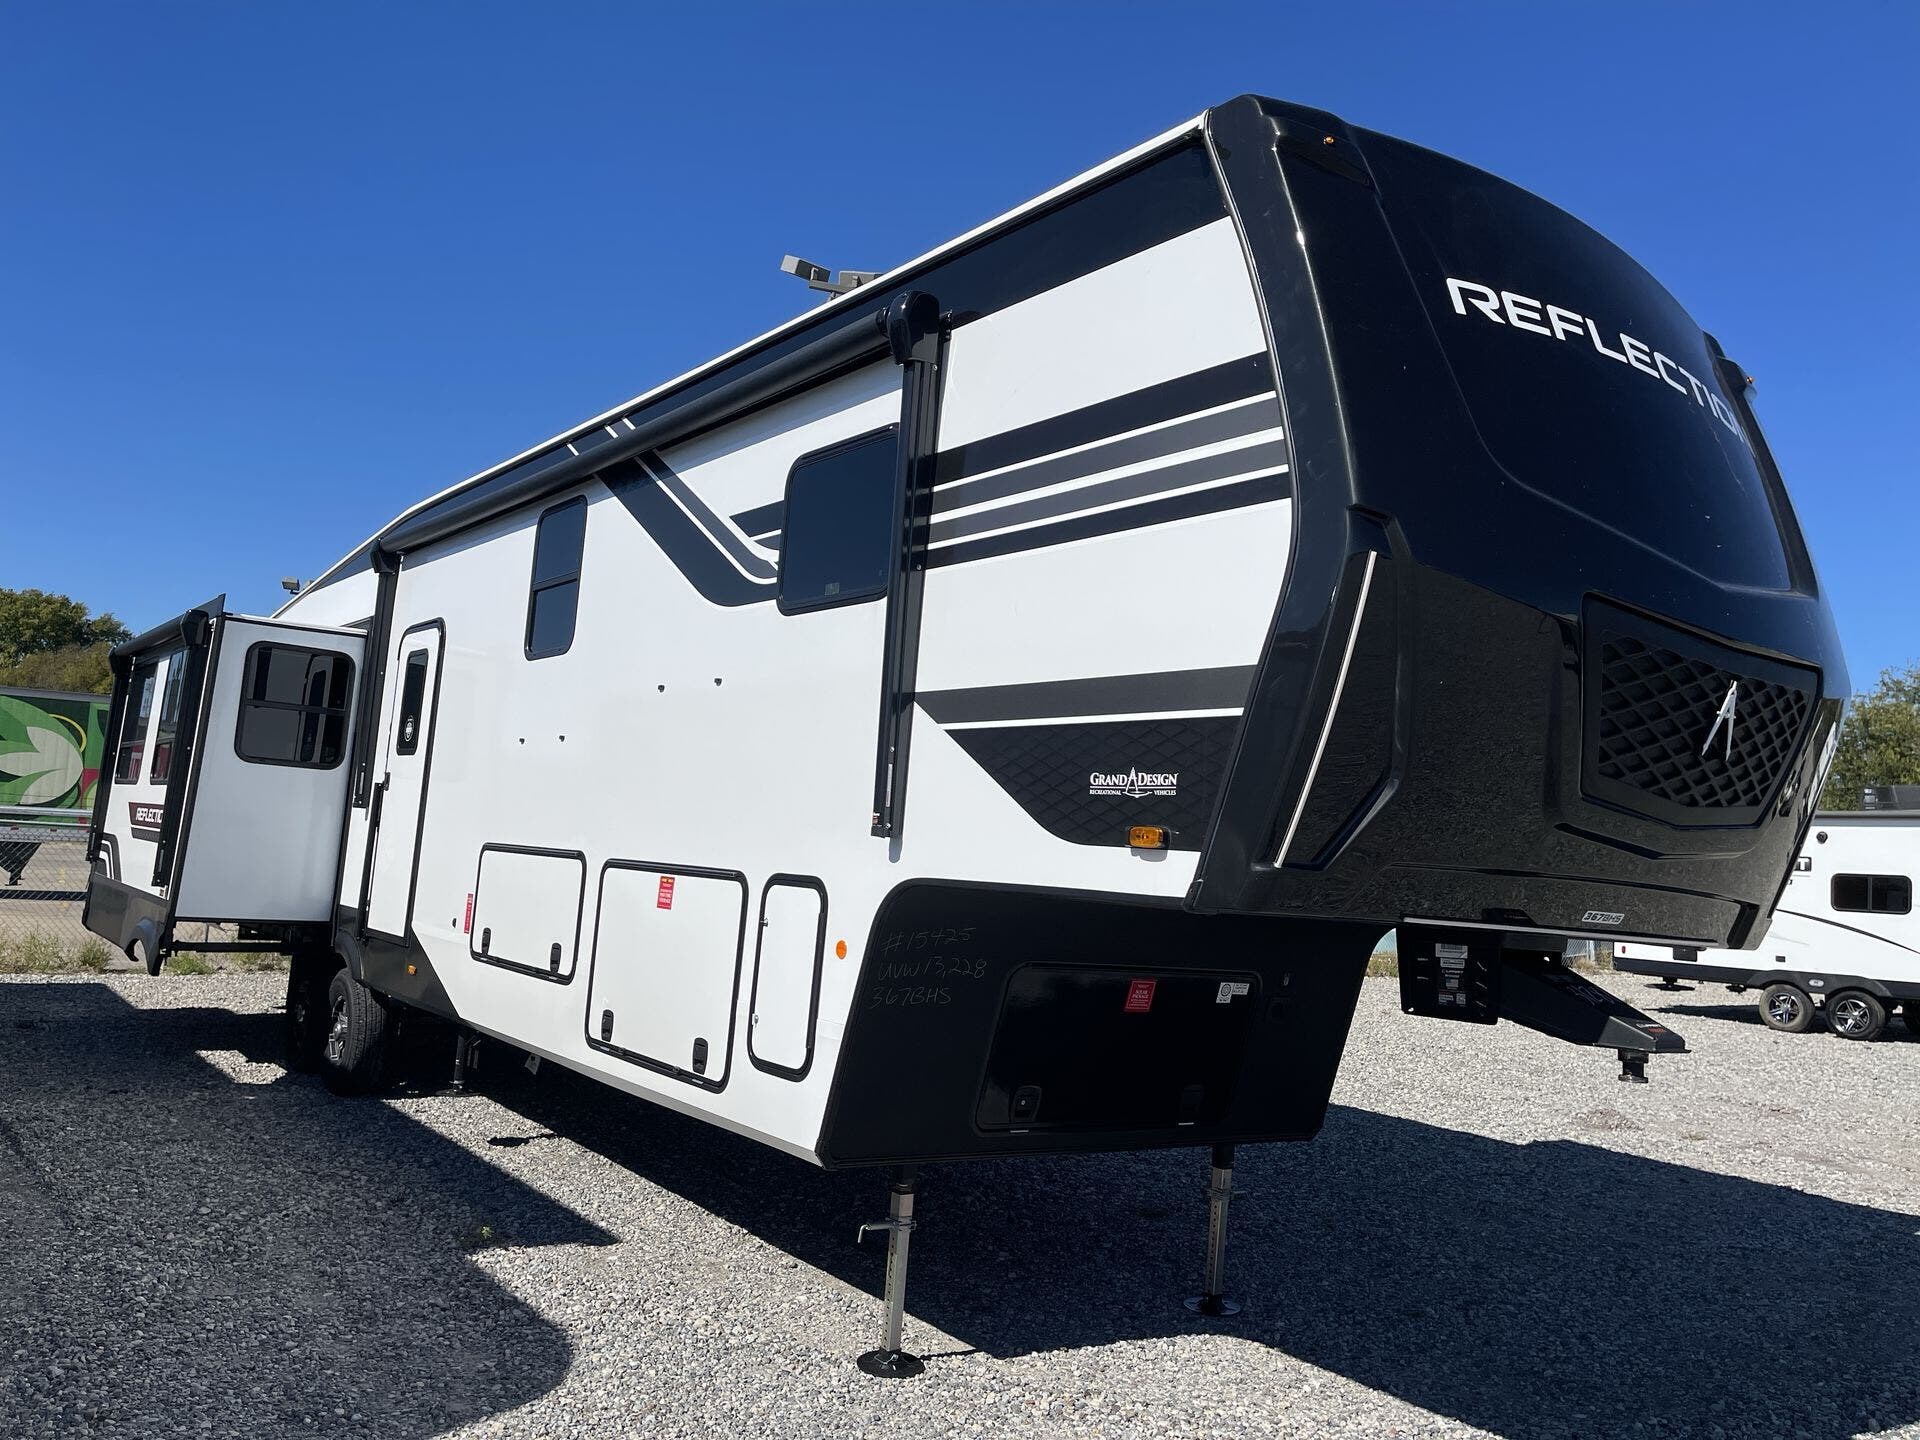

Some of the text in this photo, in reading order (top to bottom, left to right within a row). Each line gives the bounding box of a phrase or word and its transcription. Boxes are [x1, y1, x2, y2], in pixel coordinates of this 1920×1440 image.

[1446, 277, 1756, 458] REFLECTION
[1089, 772, 1179, 786] GRAND DESIGN
[136, 807, 163, 823] REFLECTIO
